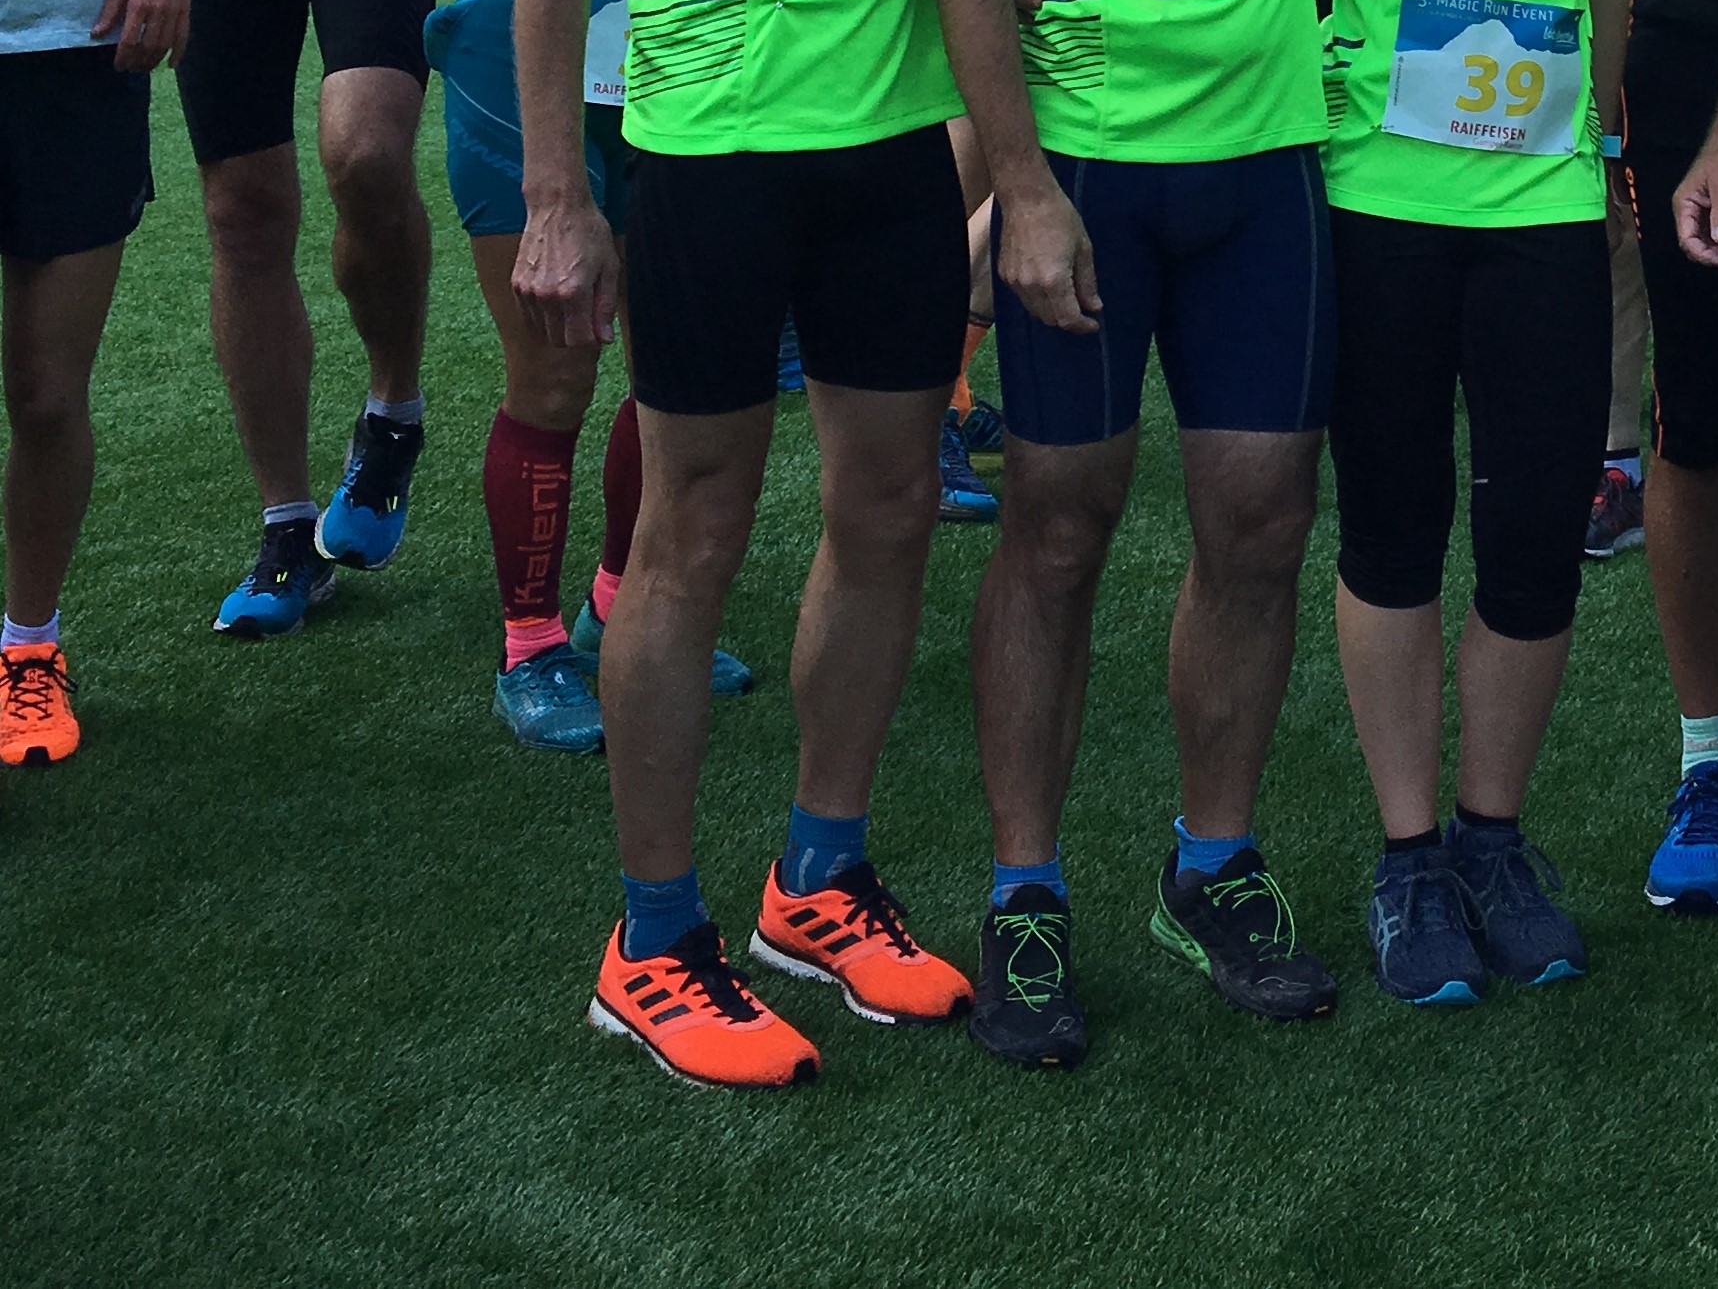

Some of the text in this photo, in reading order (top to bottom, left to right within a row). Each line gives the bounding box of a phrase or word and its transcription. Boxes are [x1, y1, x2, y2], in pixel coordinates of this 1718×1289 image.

[1484, 0, 1509, 16] RUN
[1512, 3, 1554, 22] EVENT
[1455, 54, 1545, 118] 39
[1450, 120, 1527, 141] RAIFFEISEN
